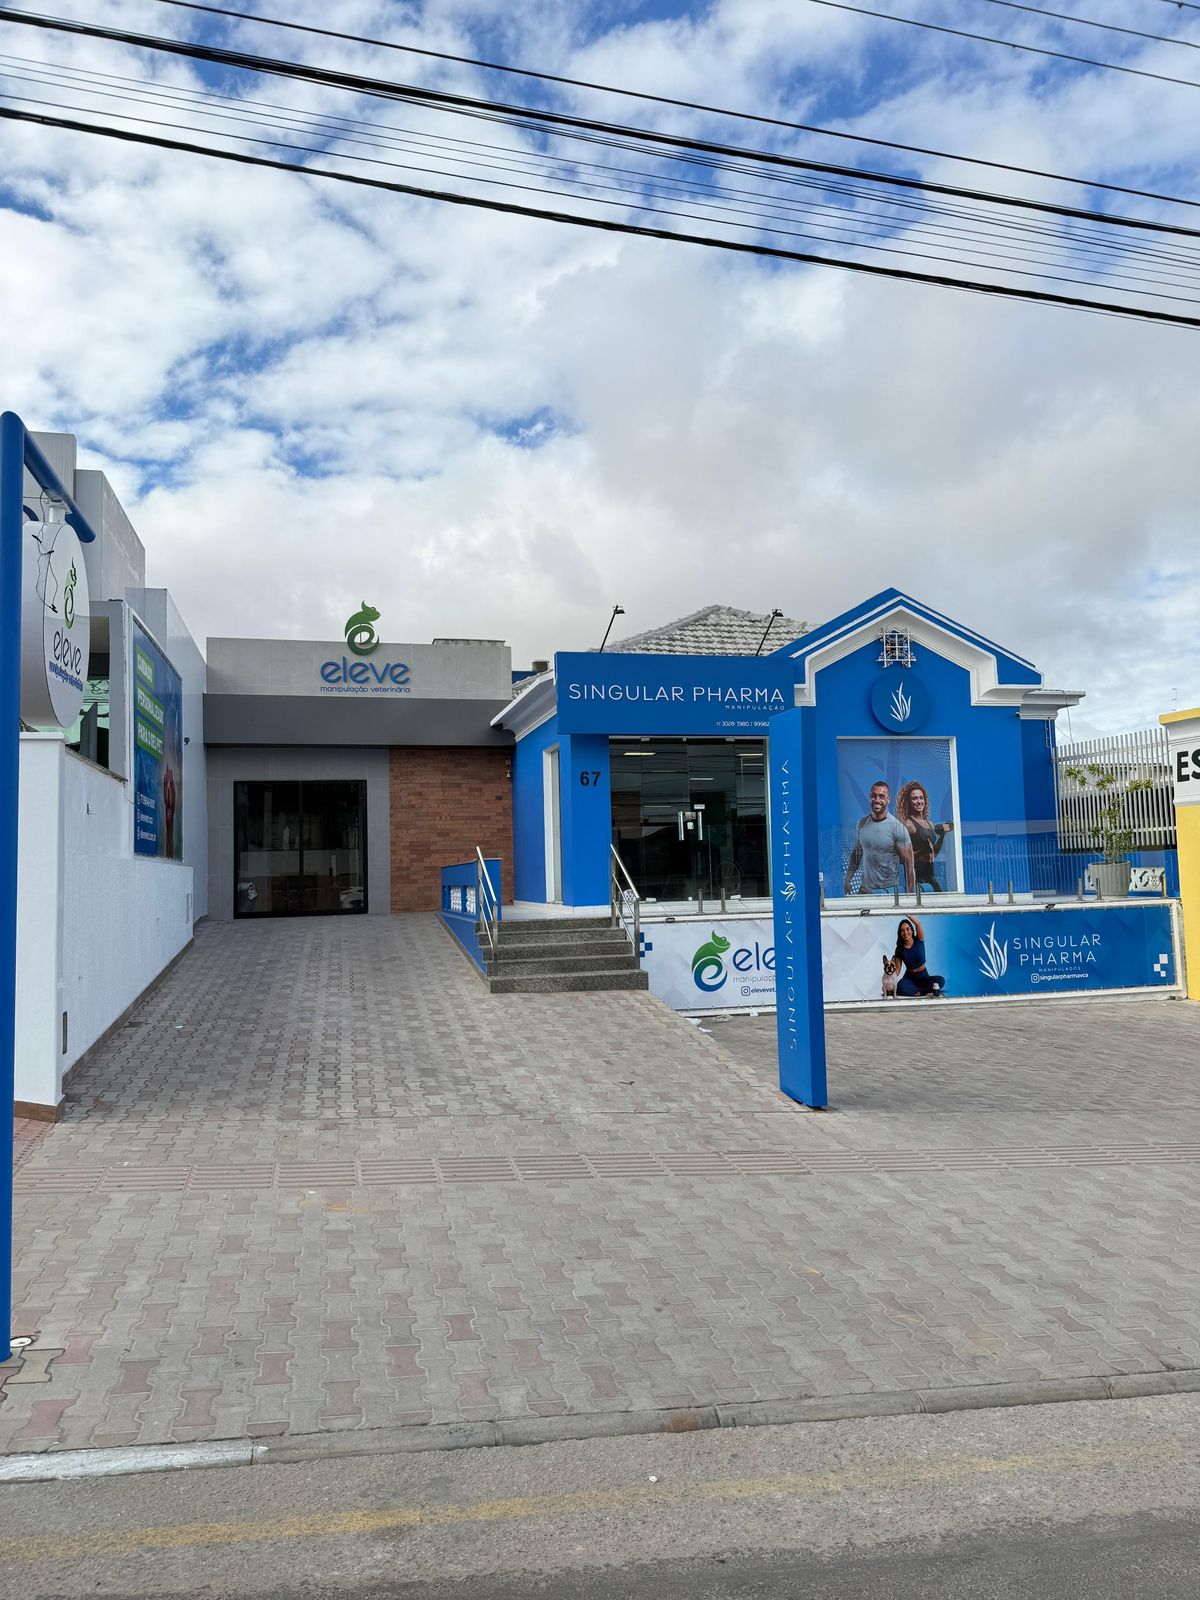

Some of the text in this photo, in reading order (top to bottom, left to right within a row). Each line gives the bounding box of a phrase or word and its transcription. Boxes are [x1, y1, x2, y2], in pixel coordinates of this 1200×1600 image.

[53, 626, 81, 676] eleve
[320, 656, 410, 685] eleve
[320, 685, 411, 694] manipulação veterinária
[569, 683, 785, 703] SINGULAR PHARMA
[580, 771, 600, 787] 67
[781, 759, 791, 876] PHARMA
[1013, 934, 1102, 950] SINGULAR
[1020, 950, 1097, 967] PHARMA
[785, 911, 797, 1050] SINGULAR
